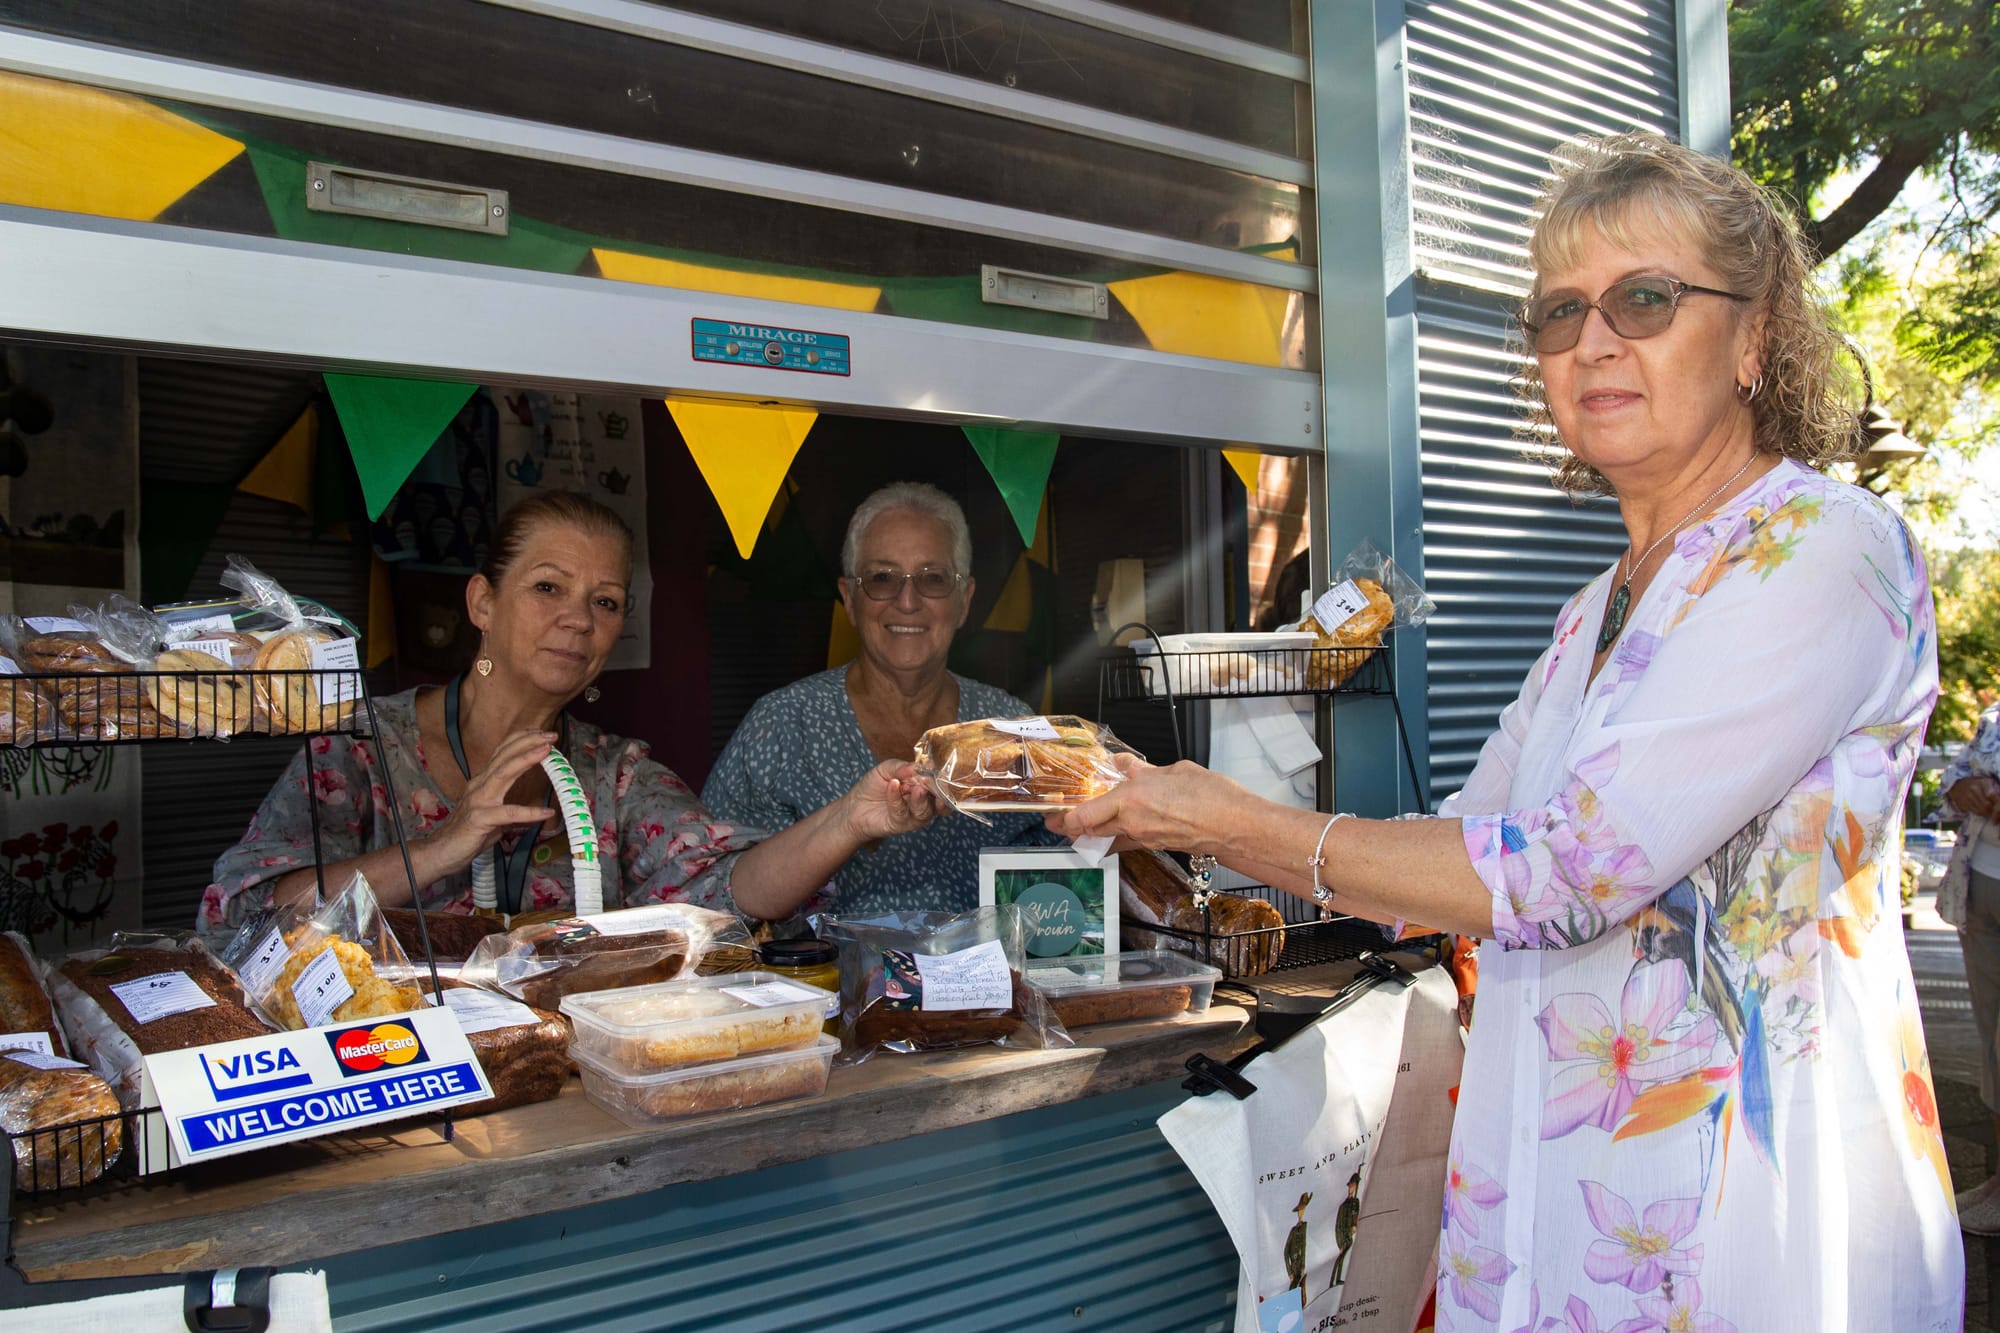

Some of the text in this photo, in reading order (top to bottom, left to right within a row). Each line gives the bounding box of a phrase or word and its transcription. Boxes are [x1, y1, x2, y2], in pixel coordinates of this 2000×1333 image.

[728, 323, 817, 345] MIRAGE
[339, 1035, 416, 1061] MasterCard
[211, 1047, 301, 1080] VISA
[204, 1070, 466, 1142] WELCOME HERE
[1258, 1166, 1306, 1184] SWEET
[1314, 1152, 1337, 1170] AND
[1338, 1302, 1354, 1313] cup
[1351, 1312, 1359, 1321] 2
[1360, 1307, 1380, 1319] tbsp
